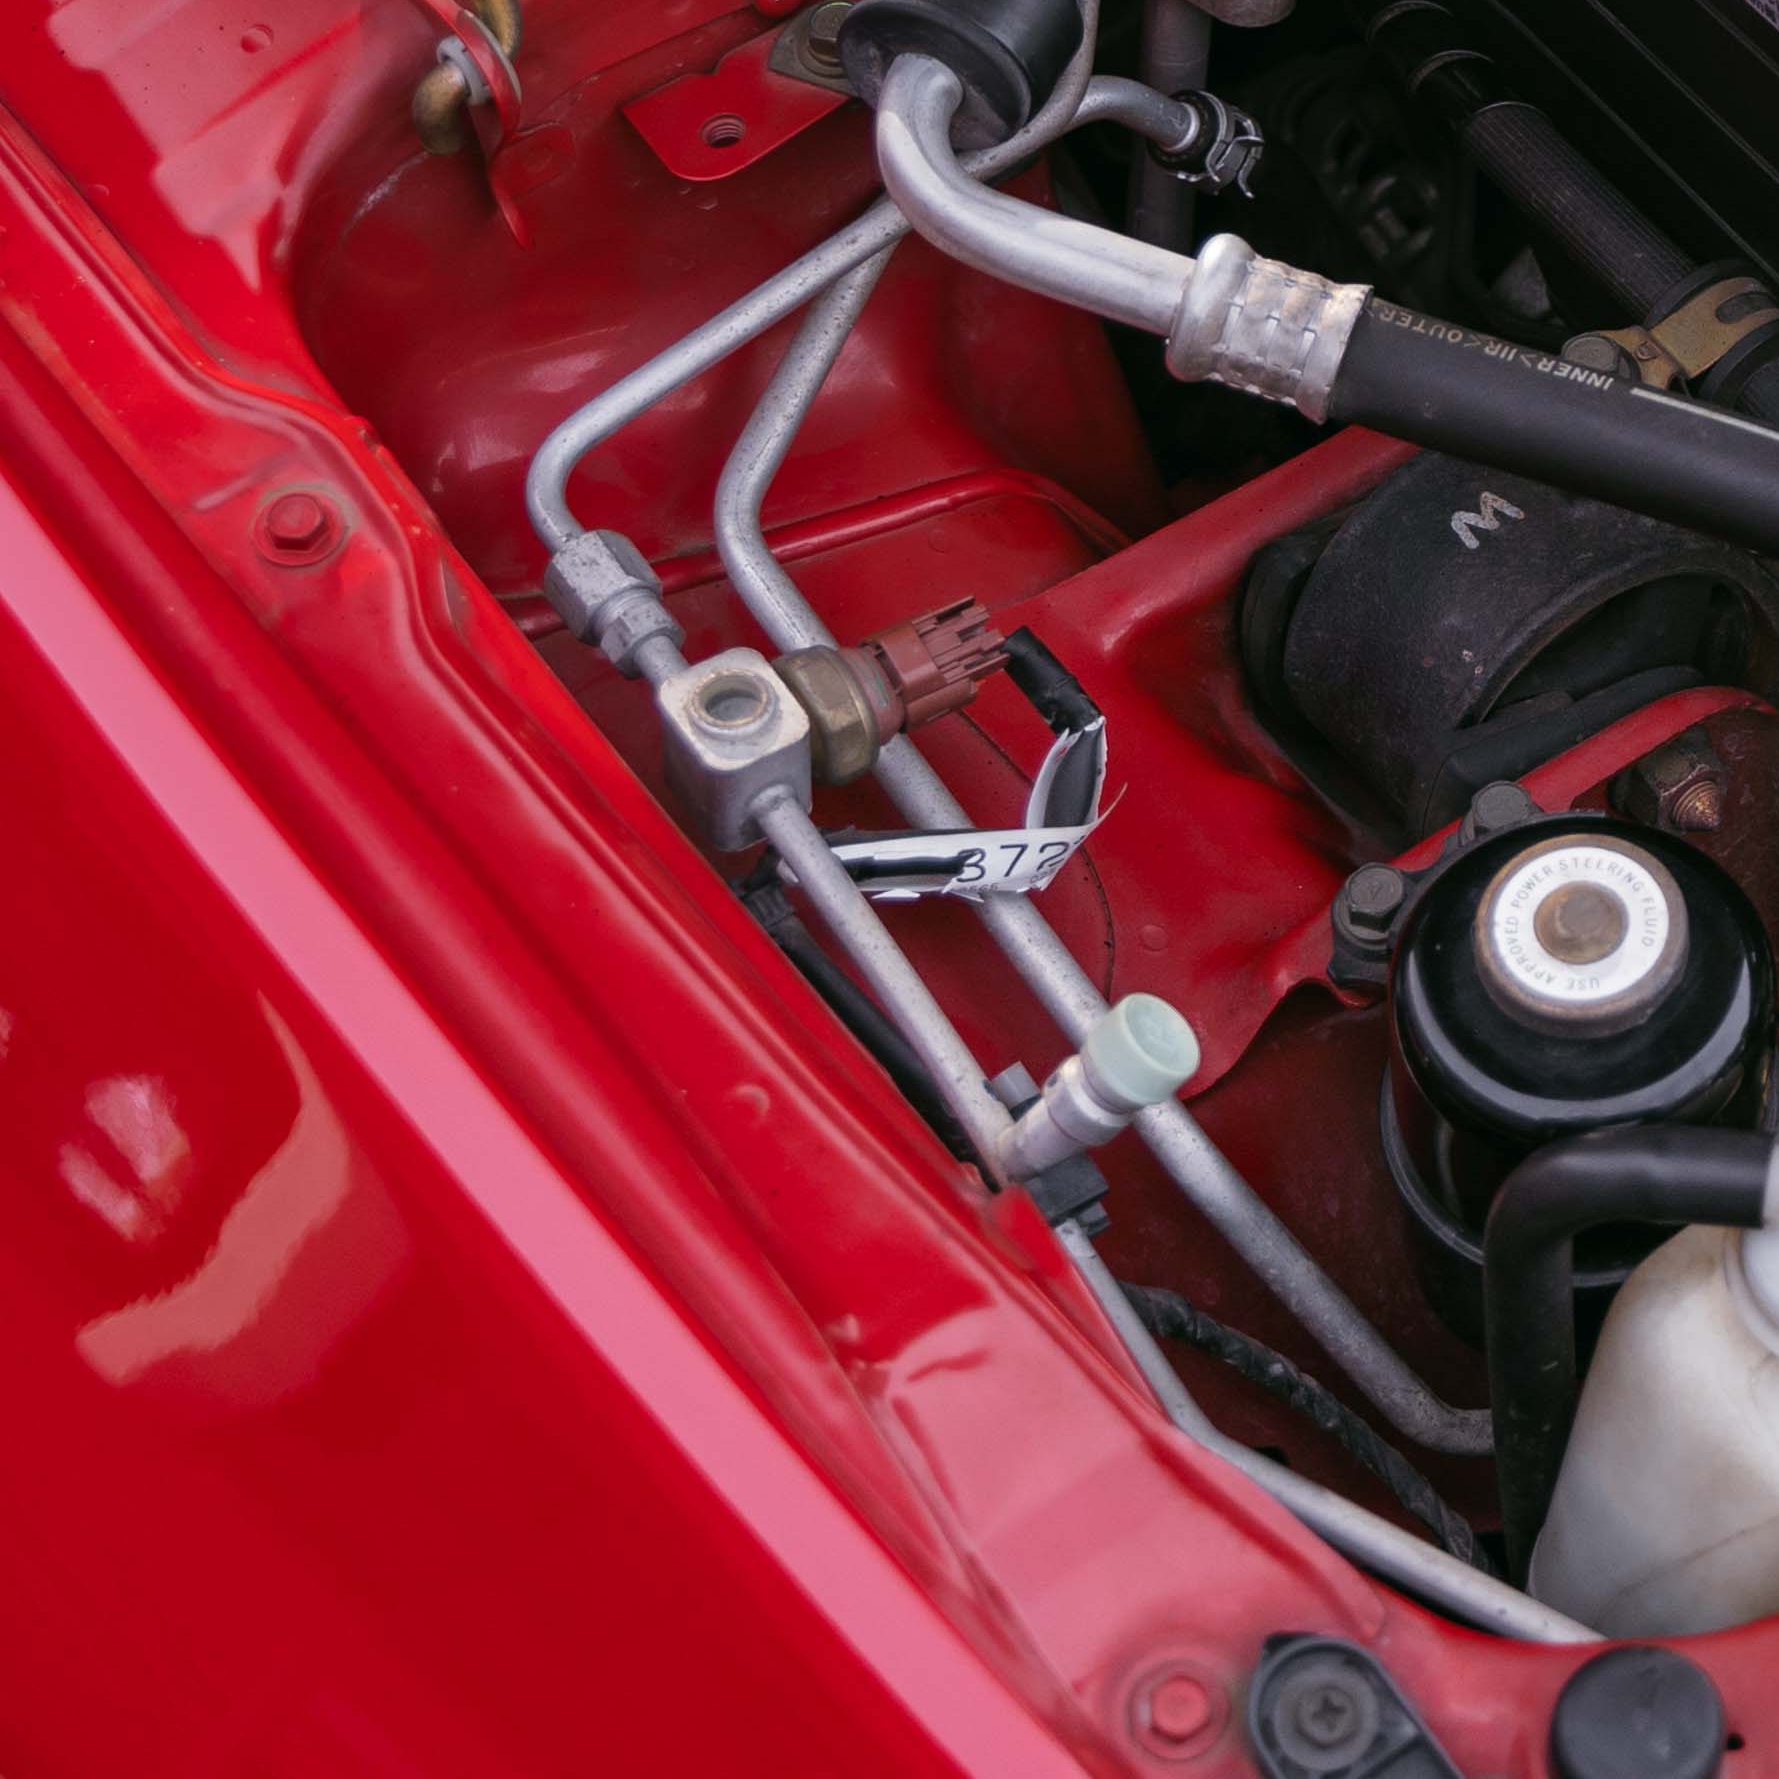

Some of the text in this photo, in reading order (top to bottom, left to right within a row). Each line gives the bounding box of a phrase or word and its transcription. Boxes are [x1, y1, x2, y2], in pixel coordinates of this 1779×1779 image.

[1504, 857, 1659, 991] USE APPROVED POWER STEERING FLUID
